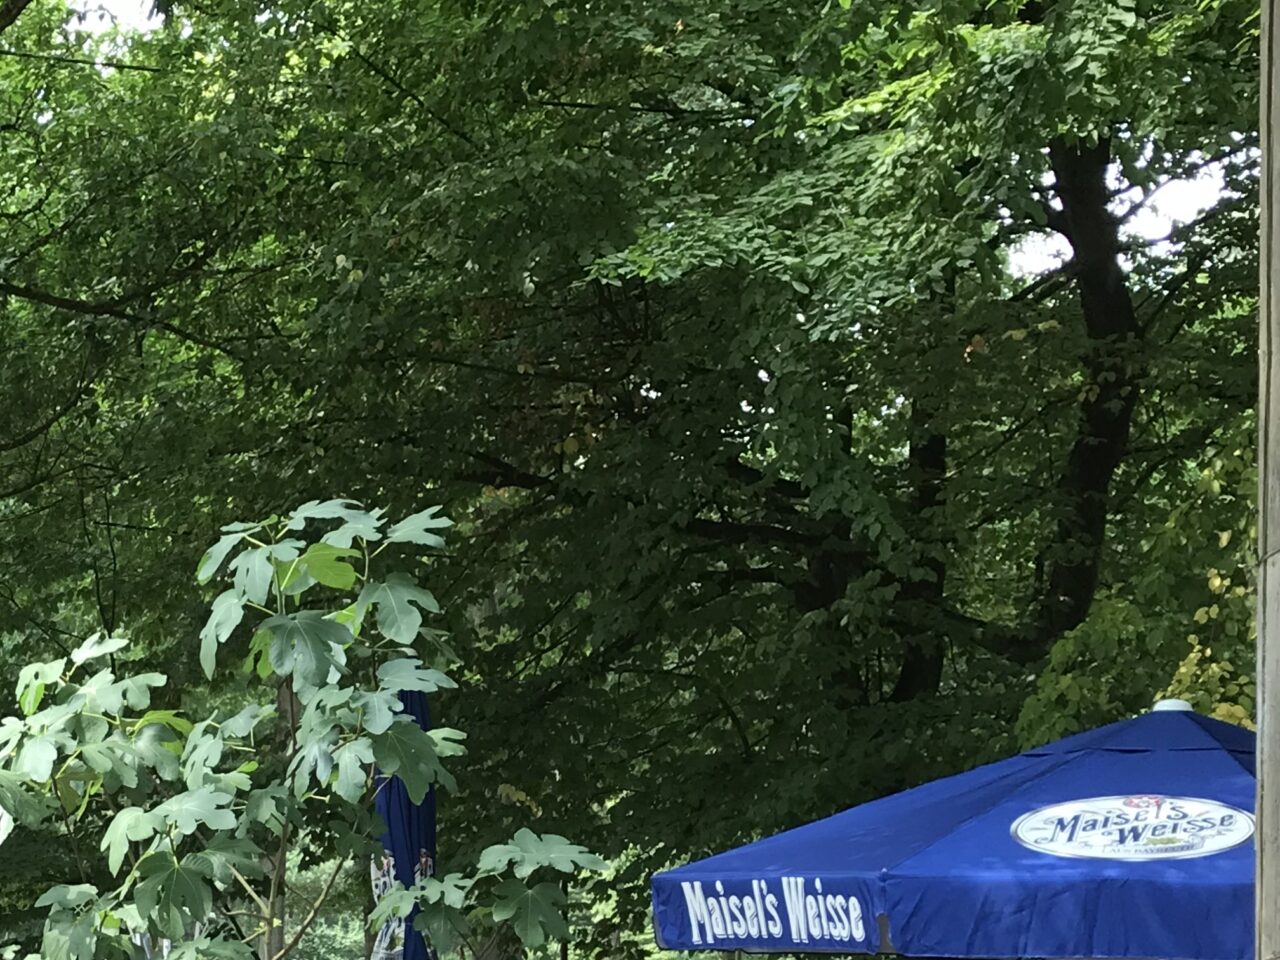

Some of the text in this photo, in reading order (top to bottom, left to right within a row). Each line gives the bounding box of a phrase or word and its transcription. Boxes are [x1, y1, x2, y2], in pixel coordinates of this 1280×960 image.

[1033, 800, 1188, 843] Maisel's
[1102, 813, 1236, 845] Weisse
[681, 876, 865, 944] Maisel's Weisse
